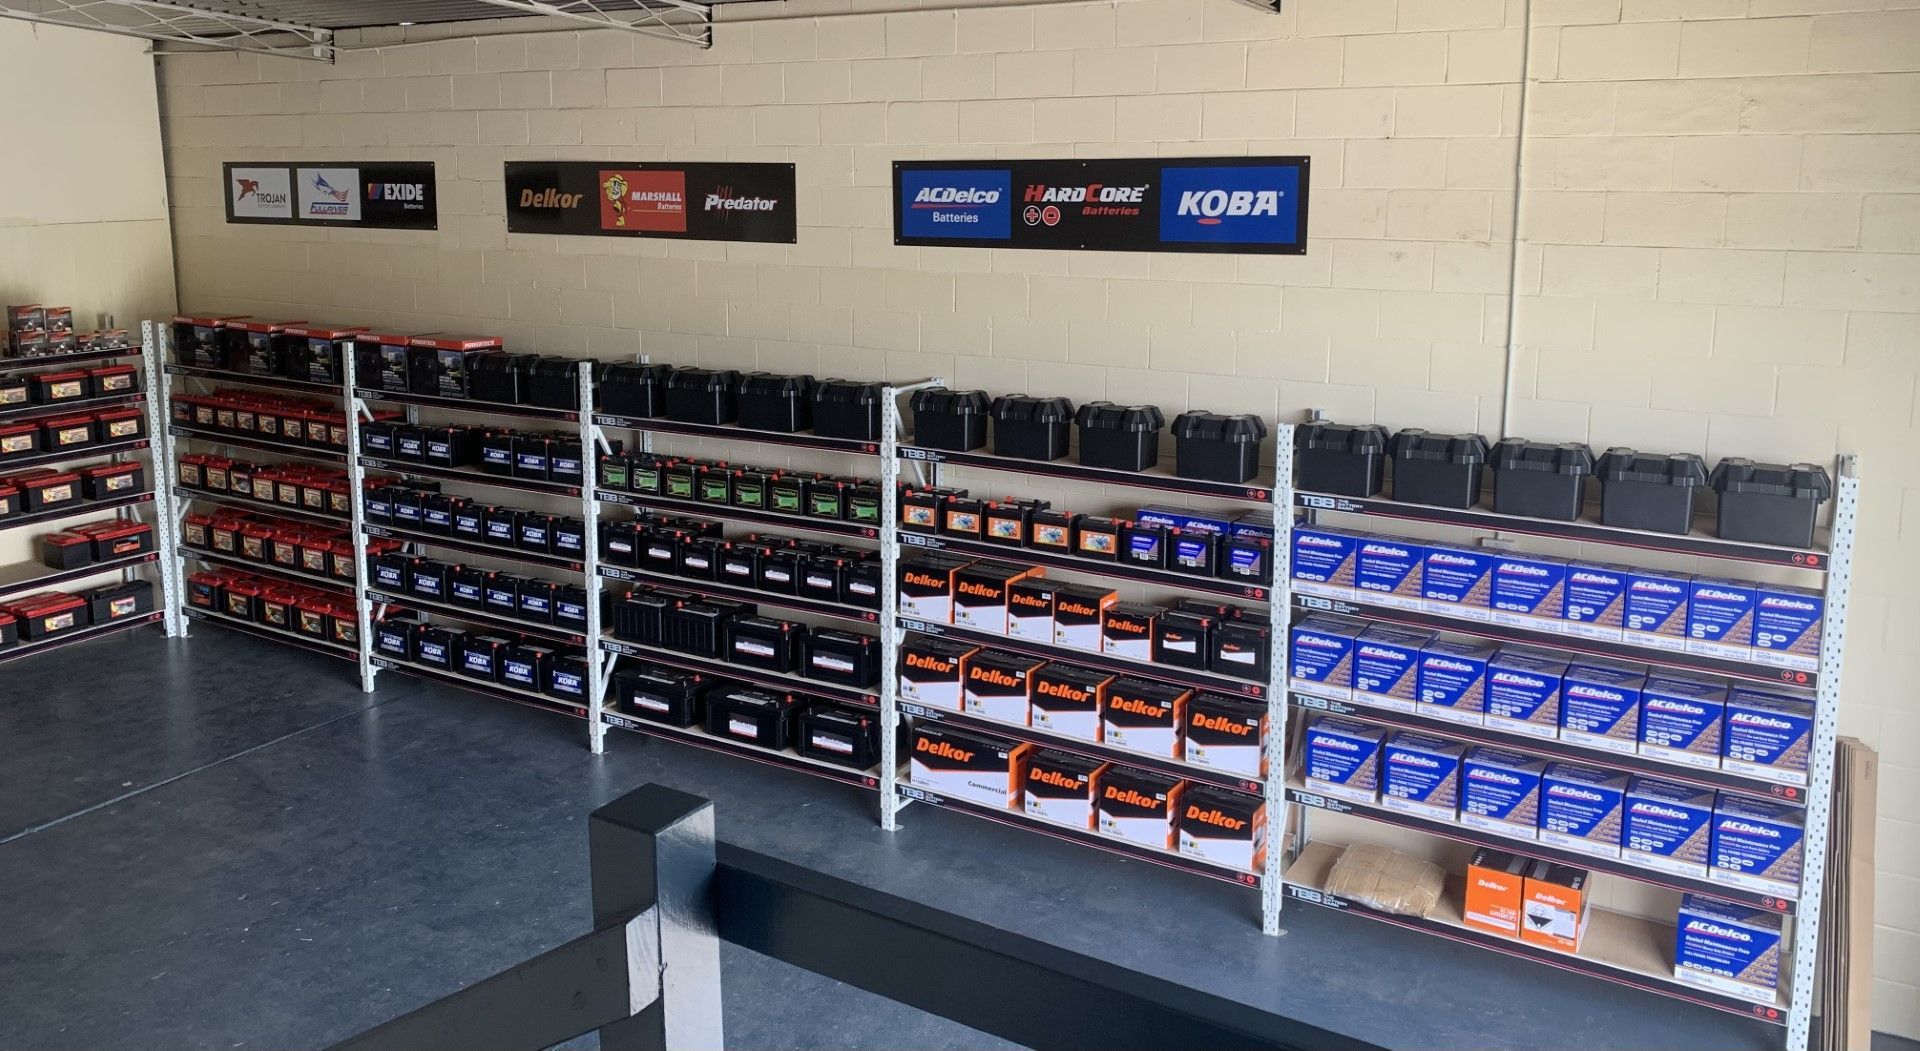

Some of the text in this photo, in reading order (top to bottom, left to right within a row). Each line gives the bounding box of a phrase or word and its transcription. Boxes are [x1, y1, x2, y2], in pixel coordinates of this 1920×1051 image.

[256, 193, 286, 203] TROJAN
[384, 184, 424, 200] EXIDE
[520, 188, 583, 208] Delkor
[631, 191, 682, 202] MARSHALL
[914, 187, 1000, 203] ACDelco
[657, 202, 682, 210] Batteries
[705, 193, 777, 212] Predator
[1177, 190, 1279, 216] KOBA
[933, 212, 979, 223] Batteries
[1082, 206, 1140, 216] Batteries
[596, 416, 616, 426] TBB
[902, 448, 926, 460] TBB
[1300, 495, 1335, 508] TBB
[901, 534, 926, 544] TBB
[1299, 536, 1342, 547] ACDelco
[1364, 544, 1408, 556] ACDelco
[1430, 554, 1476, 566] ACDelco
[601, 568, 620, 577] TBB
[1500, 564, 1548, 576] ACDelco
[904, 572, 945, 588] Delkor
[1572, 573, 1618, 584] ACDelco
[959, 582, 1001, 598] Delkor
[1633, 581, 1681, 593] ACDelco
[1012, 594, 1048, 608] Delkor
[1696, 589, 1746, 600] ACDelco
[1059, 602, 1096, 616] Delkor
[1298, 596, 1332, 610] TBB
[1762, 598, 1814, 610] ACDelco
[900, 619, 925, 630] TBB
[1107, 620, 1146, 633] Delkor
[603, 642, 622, 652] TBB
[1297, 635, 1342, 648] ACDelco
[1360, 646, 1406, 660] ACDelco
[906, 654, 953, 672] Delkor
[1424, 658, 1473, 672] ACDelco
[970, 667, 1020, 686] Delkor
[1493, 672, 1544, 687] ACDelco
[1038, 682, 1090, 702] Delkor
[1569, 686, 1622, 700] ACDelco
[1111, 696, 1167, 718] Delkor
[1295, 694, 1328, 709] TBB
[1648, 700, 1704, 714] ACDelco
[900, 703, 924, 715] TBB
[605, 716, 624, 726] TBB
[1192, 713, 1252, 736] Delkor
[1732, 713, 1792, 728] ACDelco
[916, 738, 974, 762] Delkor
[1314, 736, 1358, 750] ACDelco
[1390, 752, 1438, 768] ACDelco
[1030, 768, 1083, 790] Delkor
[1470, 769, 1520, 784] ACDelco
[900, 787, 924, 800] TBB
[968, 780, 1007, 795] Commercial
[1550, 786, 1602, 800] ACDelco
[1104, 786, 1161, 809] Delkor
[1292, 791, 1324, 808] TBB
[1186, 806, 1245, 830] Delkor
[1632, 803, 1689, 819] ACDelco
[1720, 820, 1780, 837] ACDelco
[1288, 886, 1322, 902] TBB
[1688, 921, 1750, 941] ACDelco
